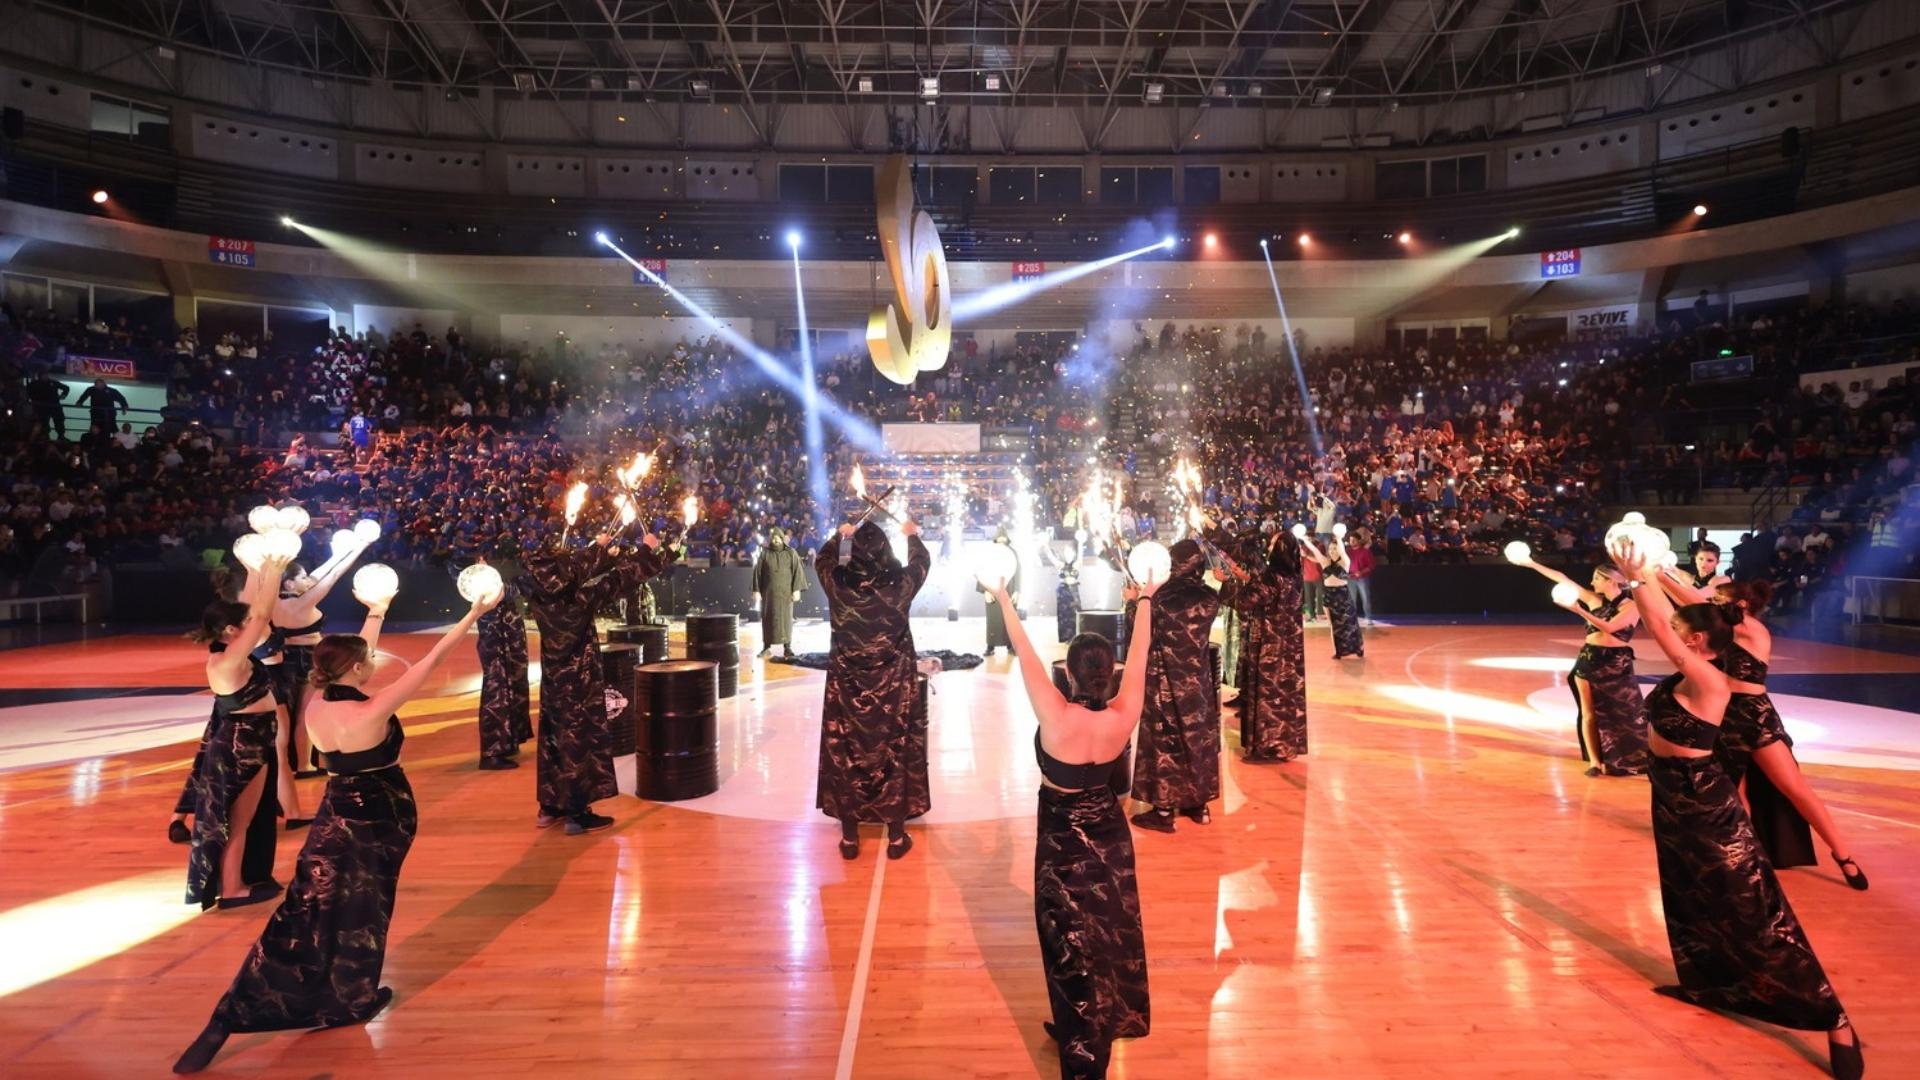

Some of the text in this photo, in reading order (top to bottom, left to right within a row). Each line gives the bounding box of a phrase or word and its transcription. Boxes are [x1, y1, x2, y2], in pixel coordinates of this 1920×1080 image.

[227, 239, 248, 251] 207
[228, 253, 249, 265] 105
[1555, 250, 1575, 261] 204
[1024, 263, 1040, 273] 205
[1556, 263, 1575, 275] 103
[1577, 310, 1629, 326] REVIVE
[100, 362, 128, 374] WC
